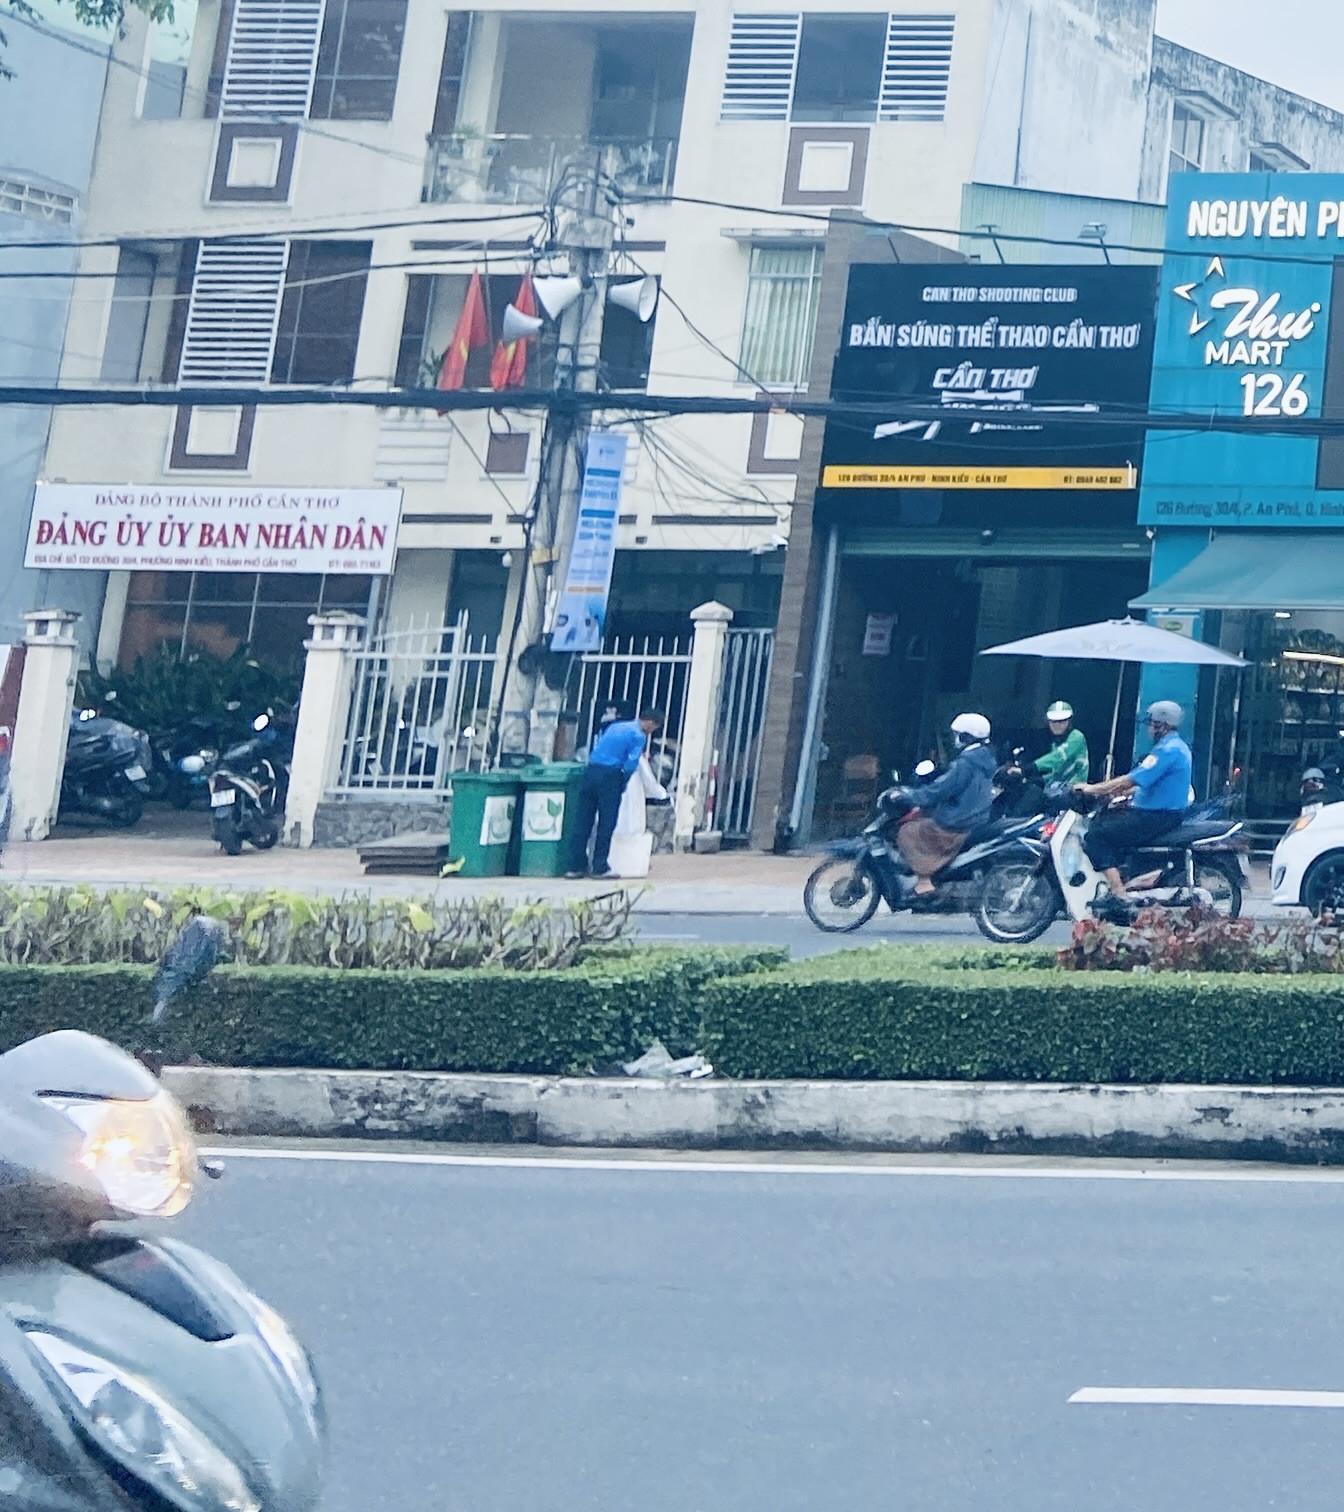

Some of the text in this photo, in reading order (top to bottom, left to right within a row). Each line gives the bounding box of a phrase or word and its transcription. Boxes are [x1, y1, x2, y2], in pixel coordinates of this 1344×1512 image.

[1187, 196, 1307, 238] NGUYÊN
[922, 287, 950, 302] CAN
[979, 287, 1042, 302] SHOOTING
[1043, 287, 1078, 302] CLUB
[957, 316, 998, 348] THỂ
[998, 325, 1051, 348] THAO
[1052, 318, 1097, 349] CẦN
[1100, 323, 1141, 349] THƠ
[1205, 341, 1289, 365] MART
[990, 365, 1040, 389] THƠ
[1240, 373, 1309, 416] 126
[36, 511, 388, 550] ĐẢNG ỦY ỦY BAN NHÂN DÂN
